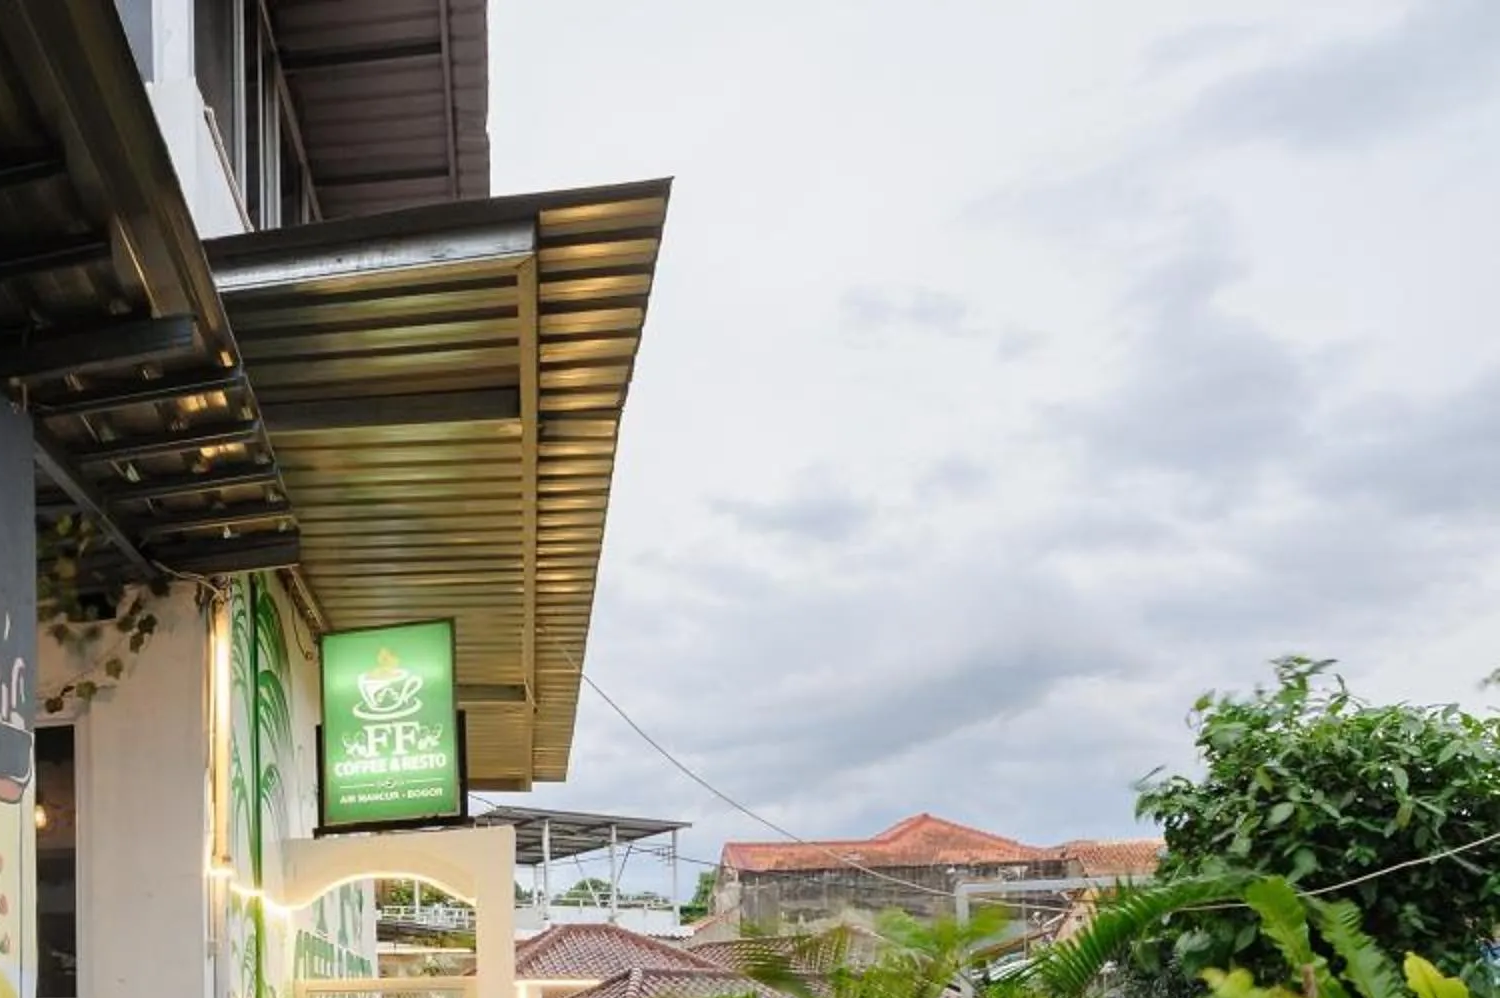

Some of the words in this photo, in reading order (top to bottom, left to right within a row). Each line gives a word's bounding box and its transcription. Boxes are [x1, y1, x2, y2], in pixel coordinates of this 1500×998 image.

[363, 721, 420, 758] FF
[403, 751, 447, 772] RESTO
[407, 787, 444, 799] BOGOR
